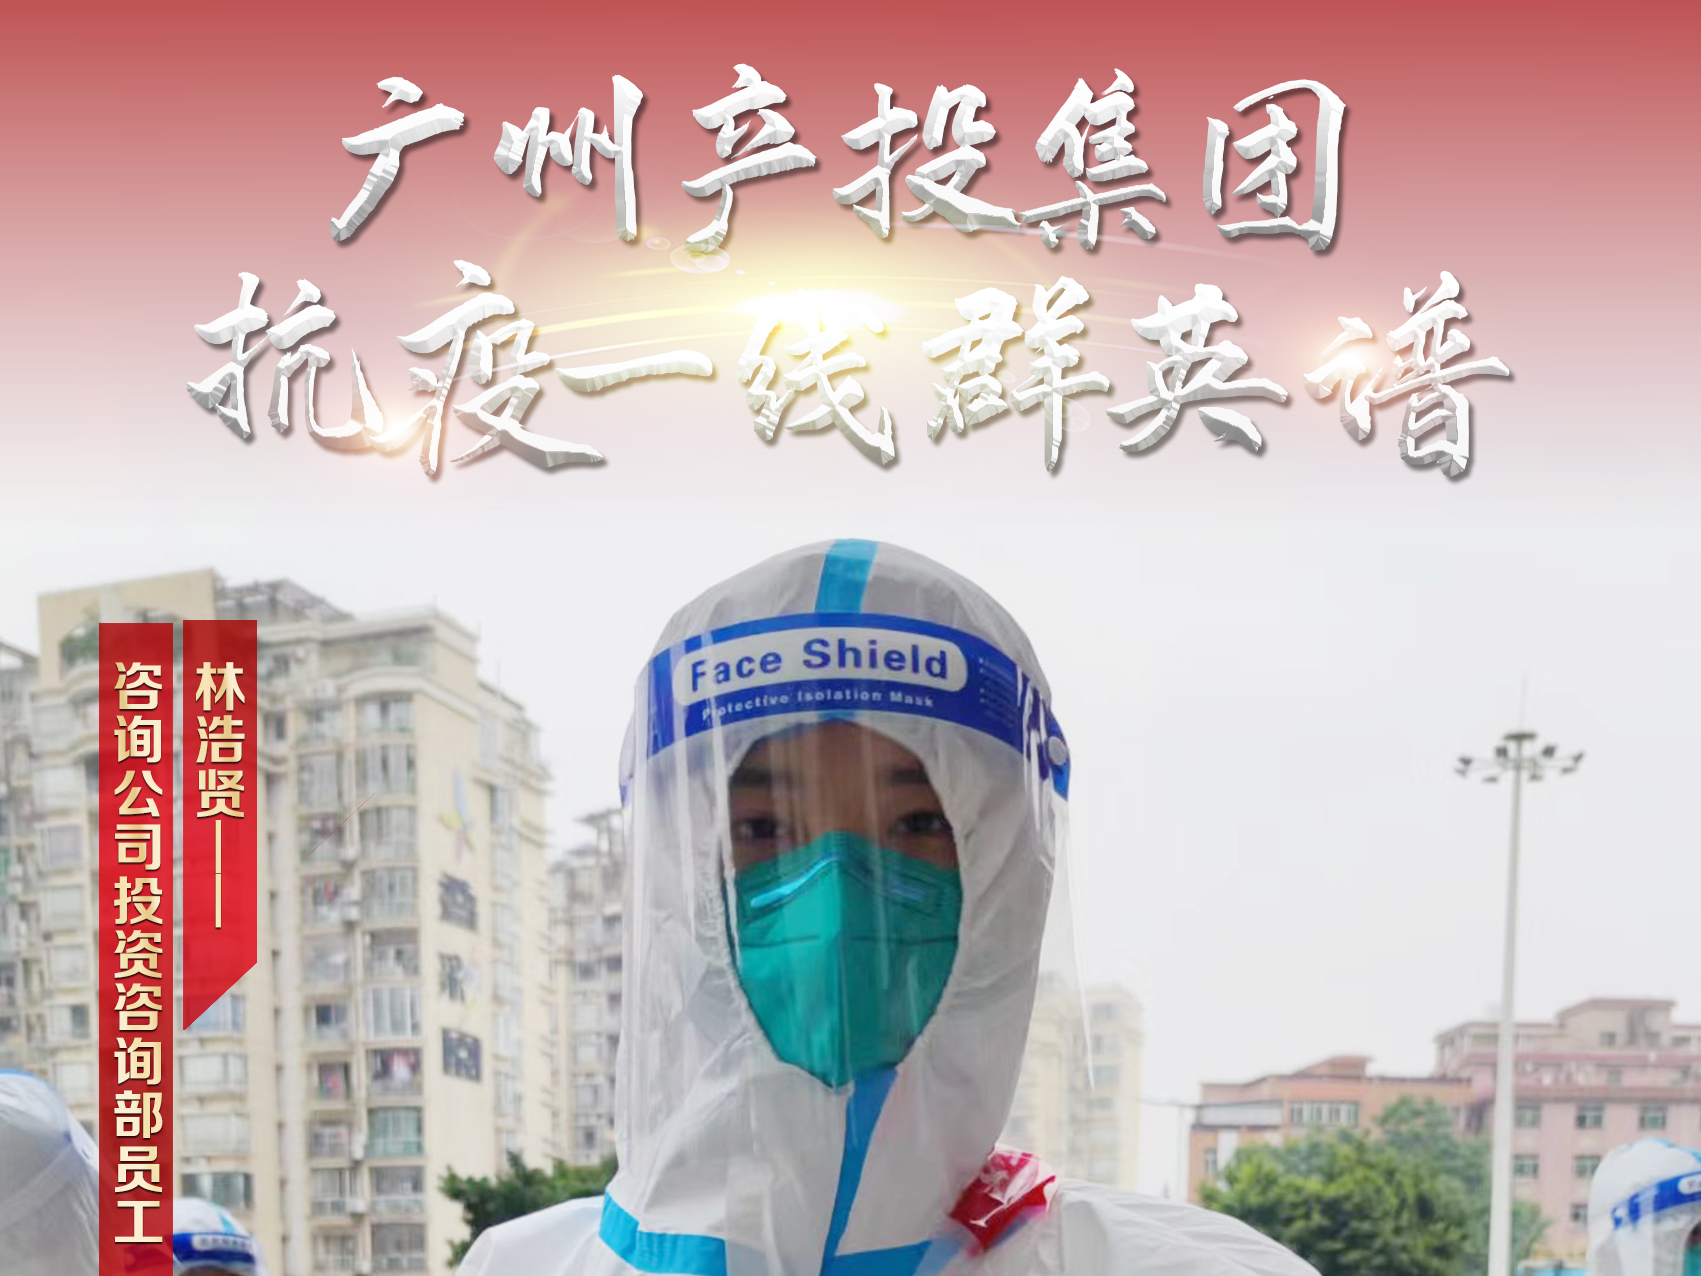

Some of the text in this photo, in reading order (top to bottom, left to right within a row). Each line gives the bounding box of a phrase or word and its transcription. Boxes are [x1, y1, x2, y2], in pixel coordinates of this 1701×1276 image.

[691, 638, 948, 693] Face Shield
[702, 689, 934, 721] Potective Isolation Mask
